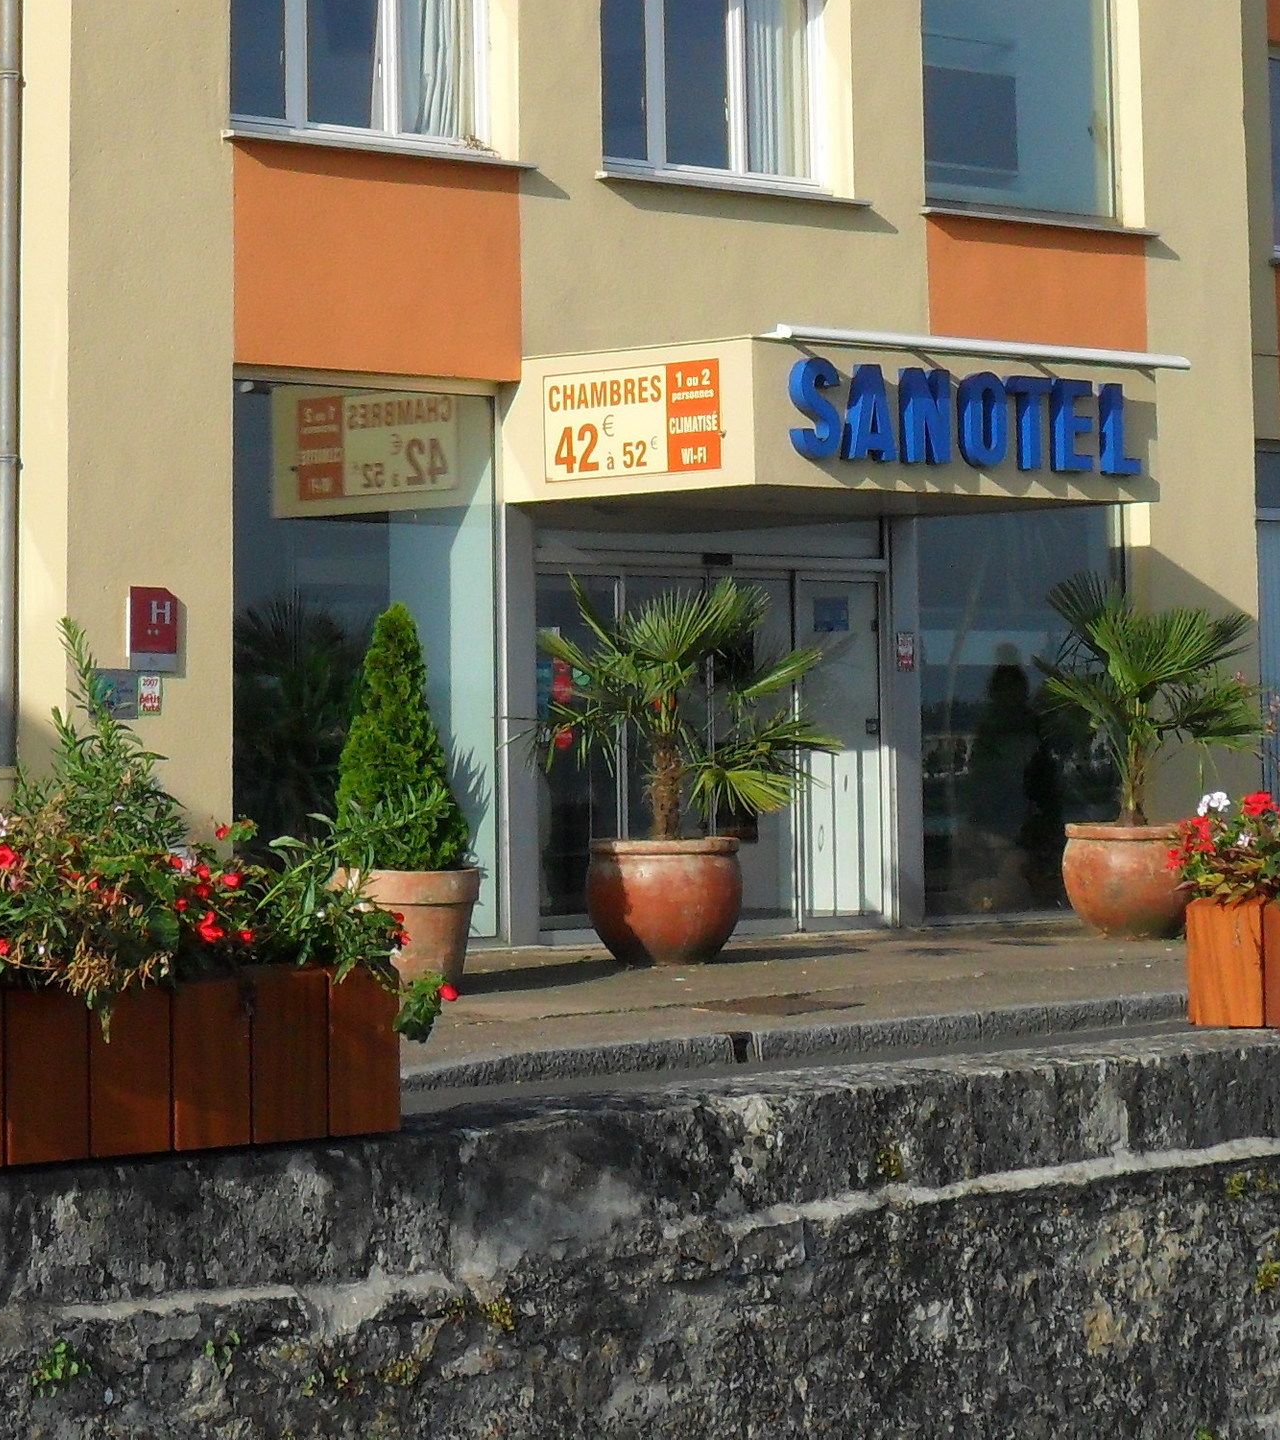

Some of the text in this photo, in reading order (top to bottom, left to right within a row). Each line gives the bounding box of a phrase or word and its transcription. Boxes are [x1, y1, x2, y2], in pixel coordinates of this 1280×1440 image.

[675, 368, 711, 387] 1 ou 2
[549, 375, 662, 412] CHAMBRES
[669, 411, 718, 435] CLIMATISÉ
[788, 357, 1144, 476] SANOTEL
[606, 452, 615, 471] à
[680, 446, 708, 465] WI-FI
[151, 600, 171, 624] H
